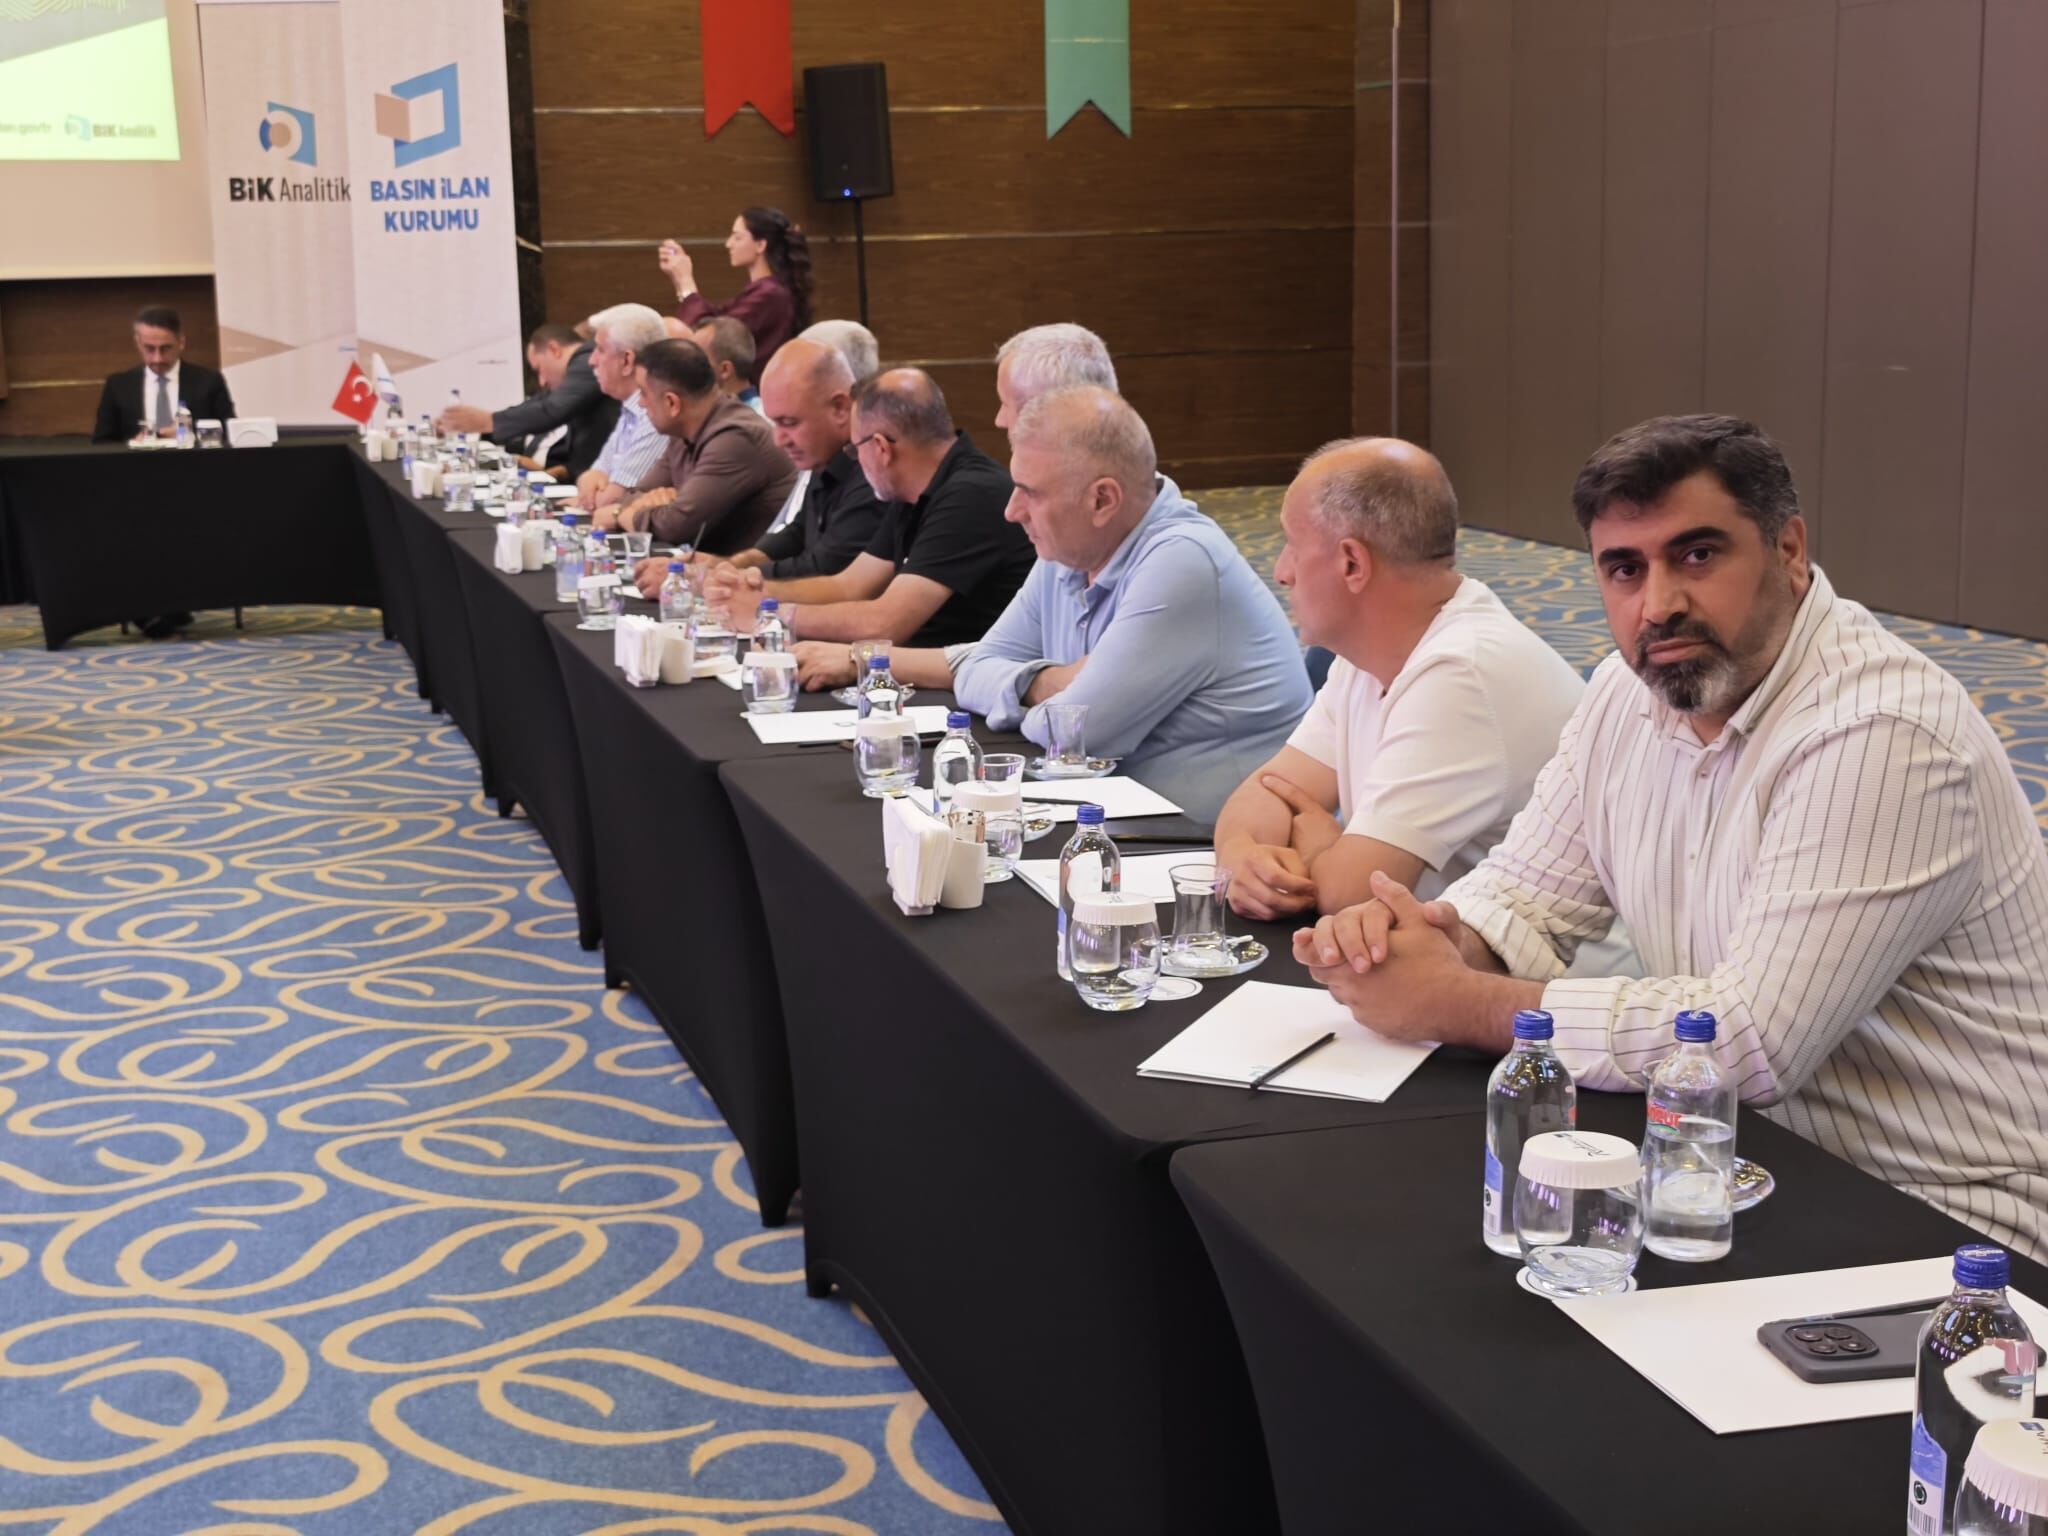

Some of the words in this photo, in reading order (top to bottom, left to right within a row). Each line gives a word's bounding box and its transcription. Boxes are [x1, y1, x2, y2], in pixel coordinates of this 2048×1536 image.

[280, 177, 352, 202] Analitik
[370, 179, 436, 202] BASIN
[384, 208, 479, 233] KURUMU
